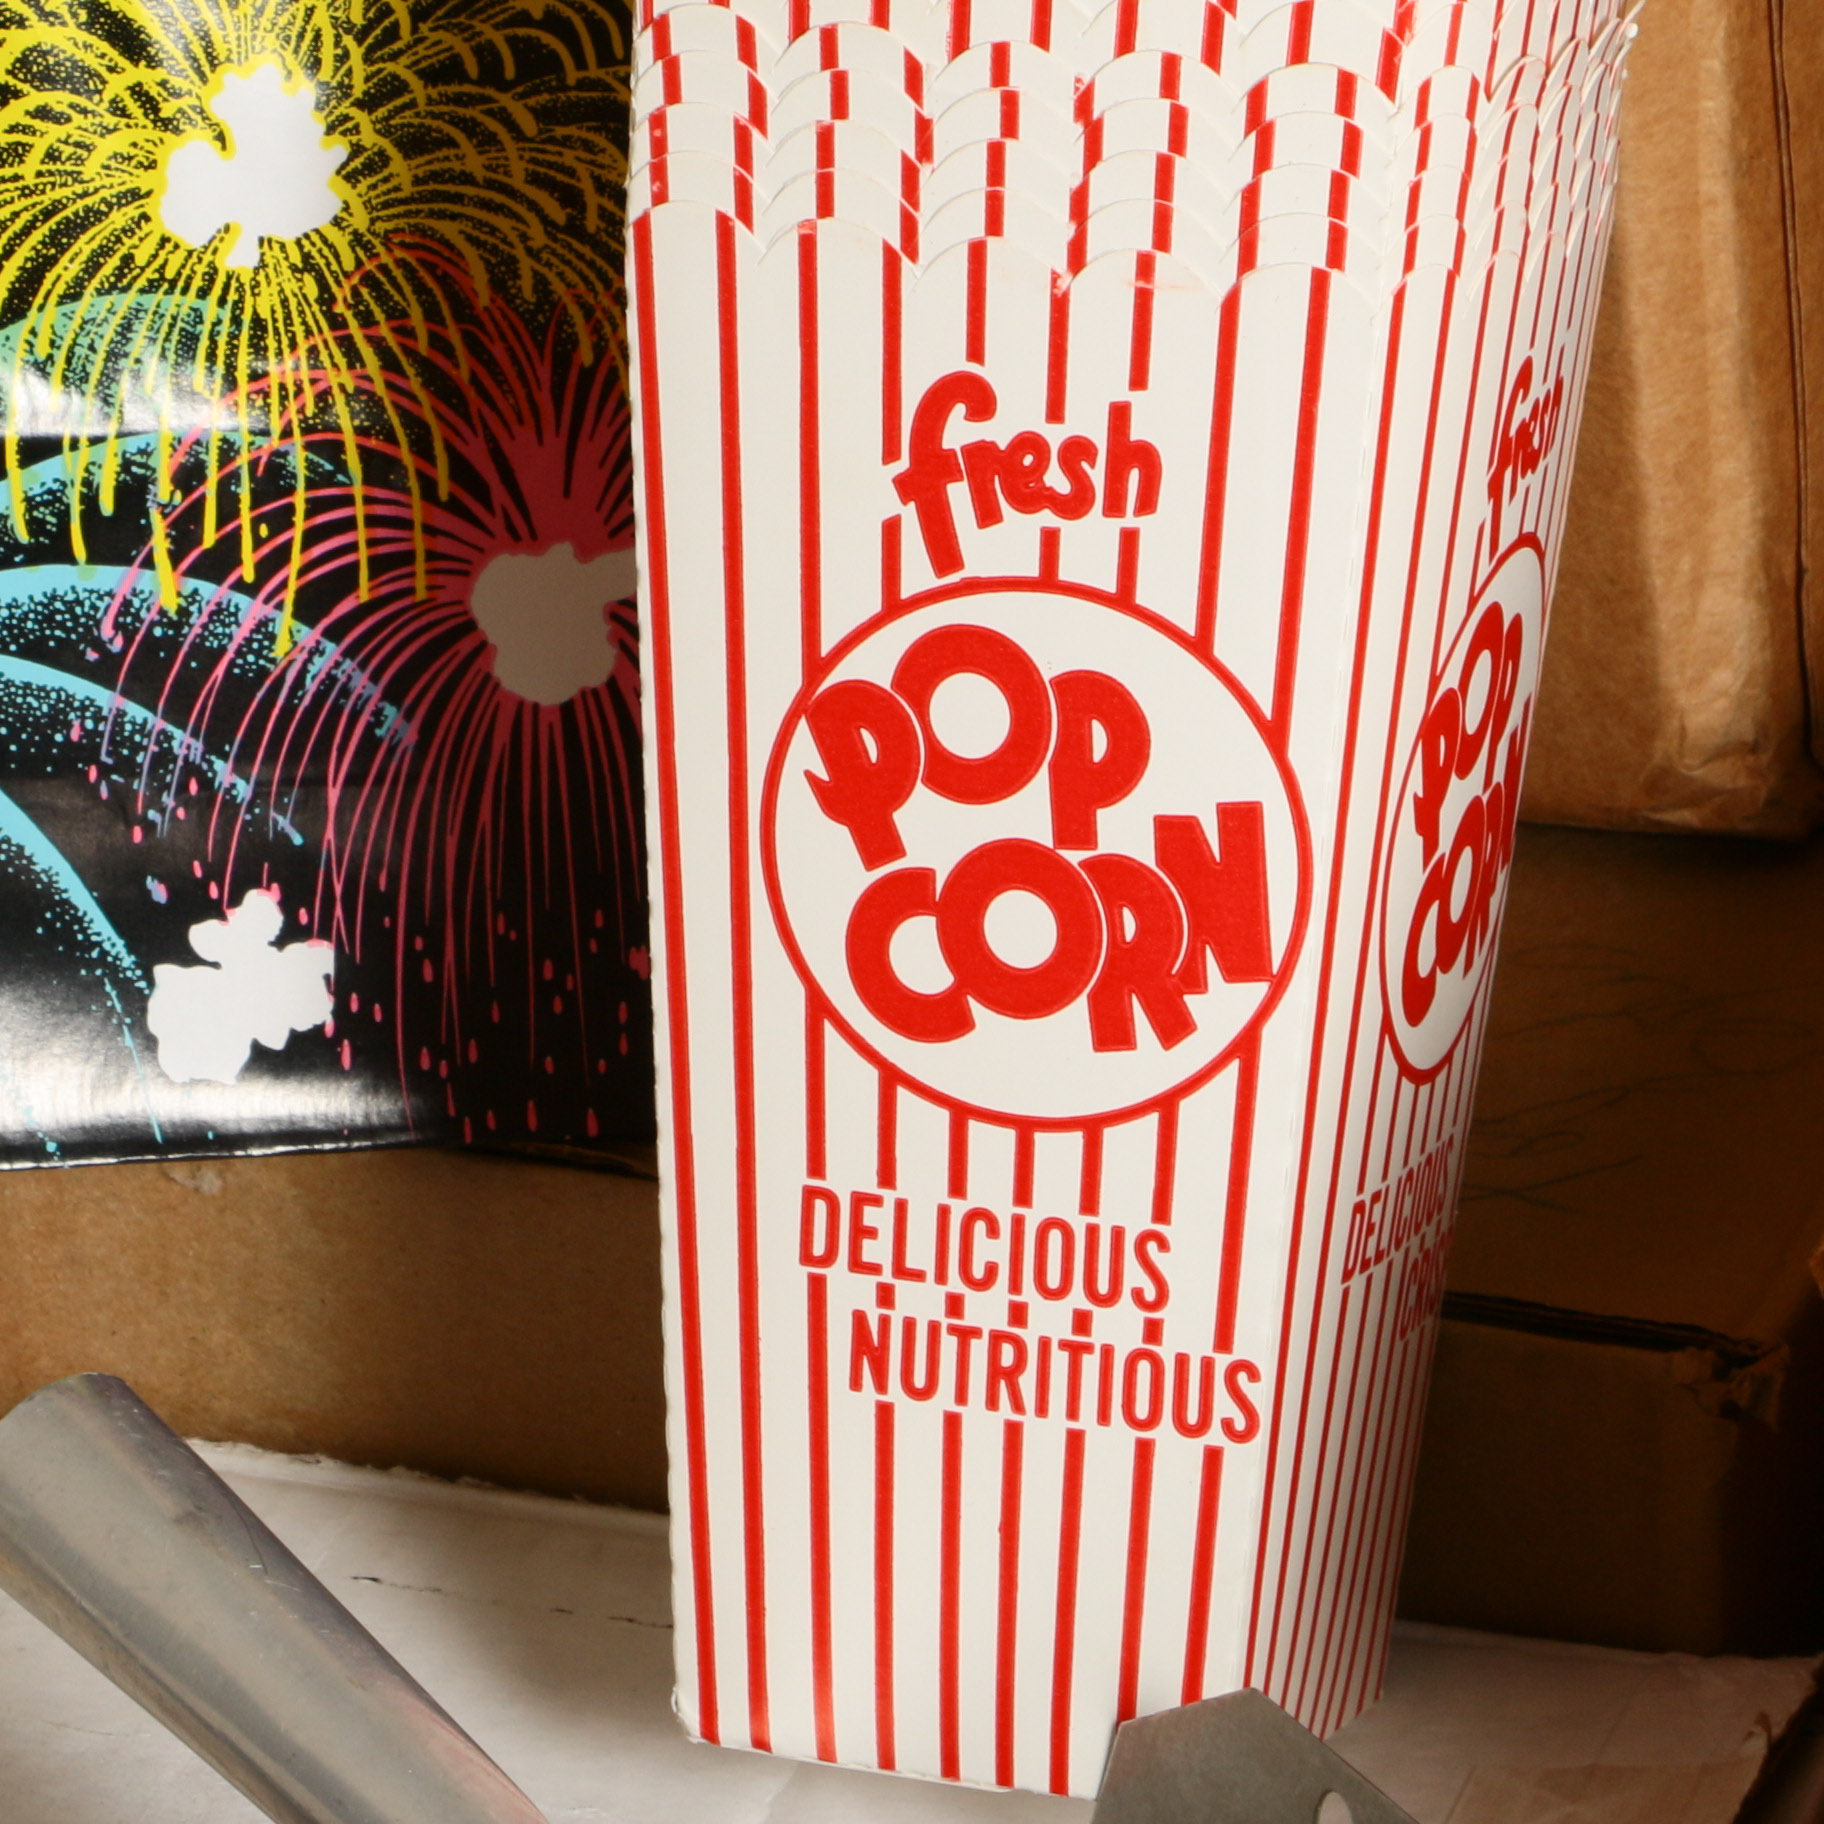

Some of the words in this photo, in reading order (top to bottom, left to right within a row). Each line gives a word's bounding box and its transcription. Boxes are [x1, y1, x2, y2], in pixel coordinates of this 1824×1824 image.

[894, 370, 1162, 578] fresh
[1488, 355, 1563, 565] fresh
[803, 623, 1151, 871] POP
[1413, 601, 1523, 874] POP
[845, 801, 1272, 1053] CORN
[1401, 691, 1531, 1027] CORN
[799, 1185, 1170, 1314] DELICIOUS
[1341, 1132, 1454, 1285] DELICIOUS
[850, 1309, 1262, 1444] NUTRITIOUS
